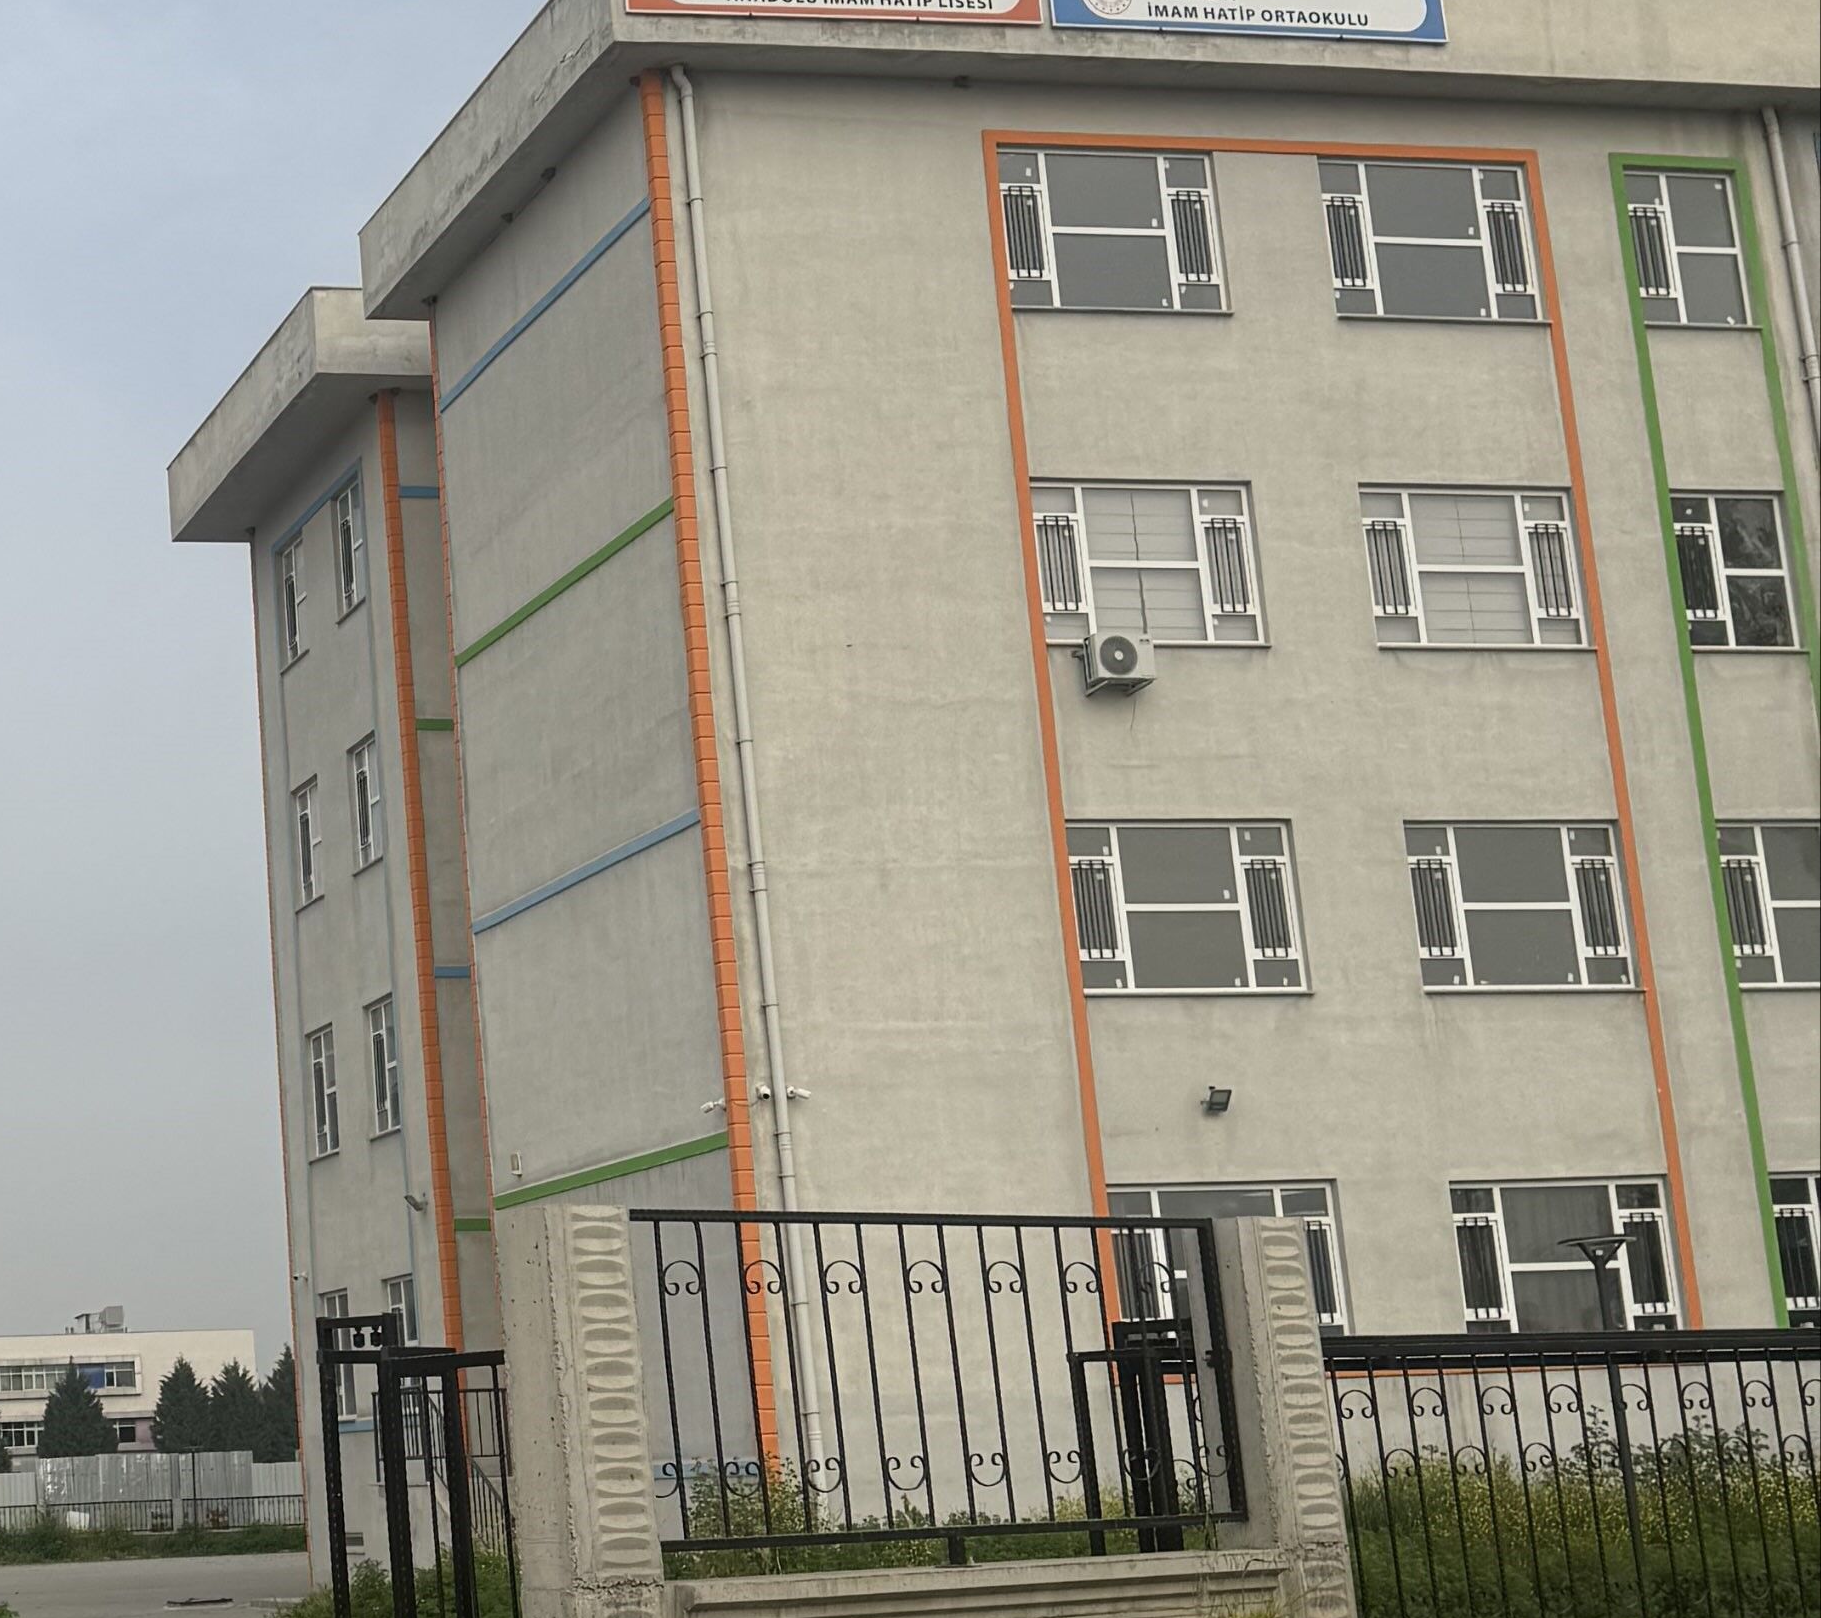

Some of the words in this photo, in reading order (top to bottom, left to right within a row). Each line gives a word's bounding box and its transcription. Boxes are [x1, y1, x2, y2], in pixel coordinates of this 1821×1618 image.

[1147, 1, 1199, 19] İMAM
[1203, 5, 1256, 22] HATİP
[1261, 8, 1369, 27] ORTAOKULU
